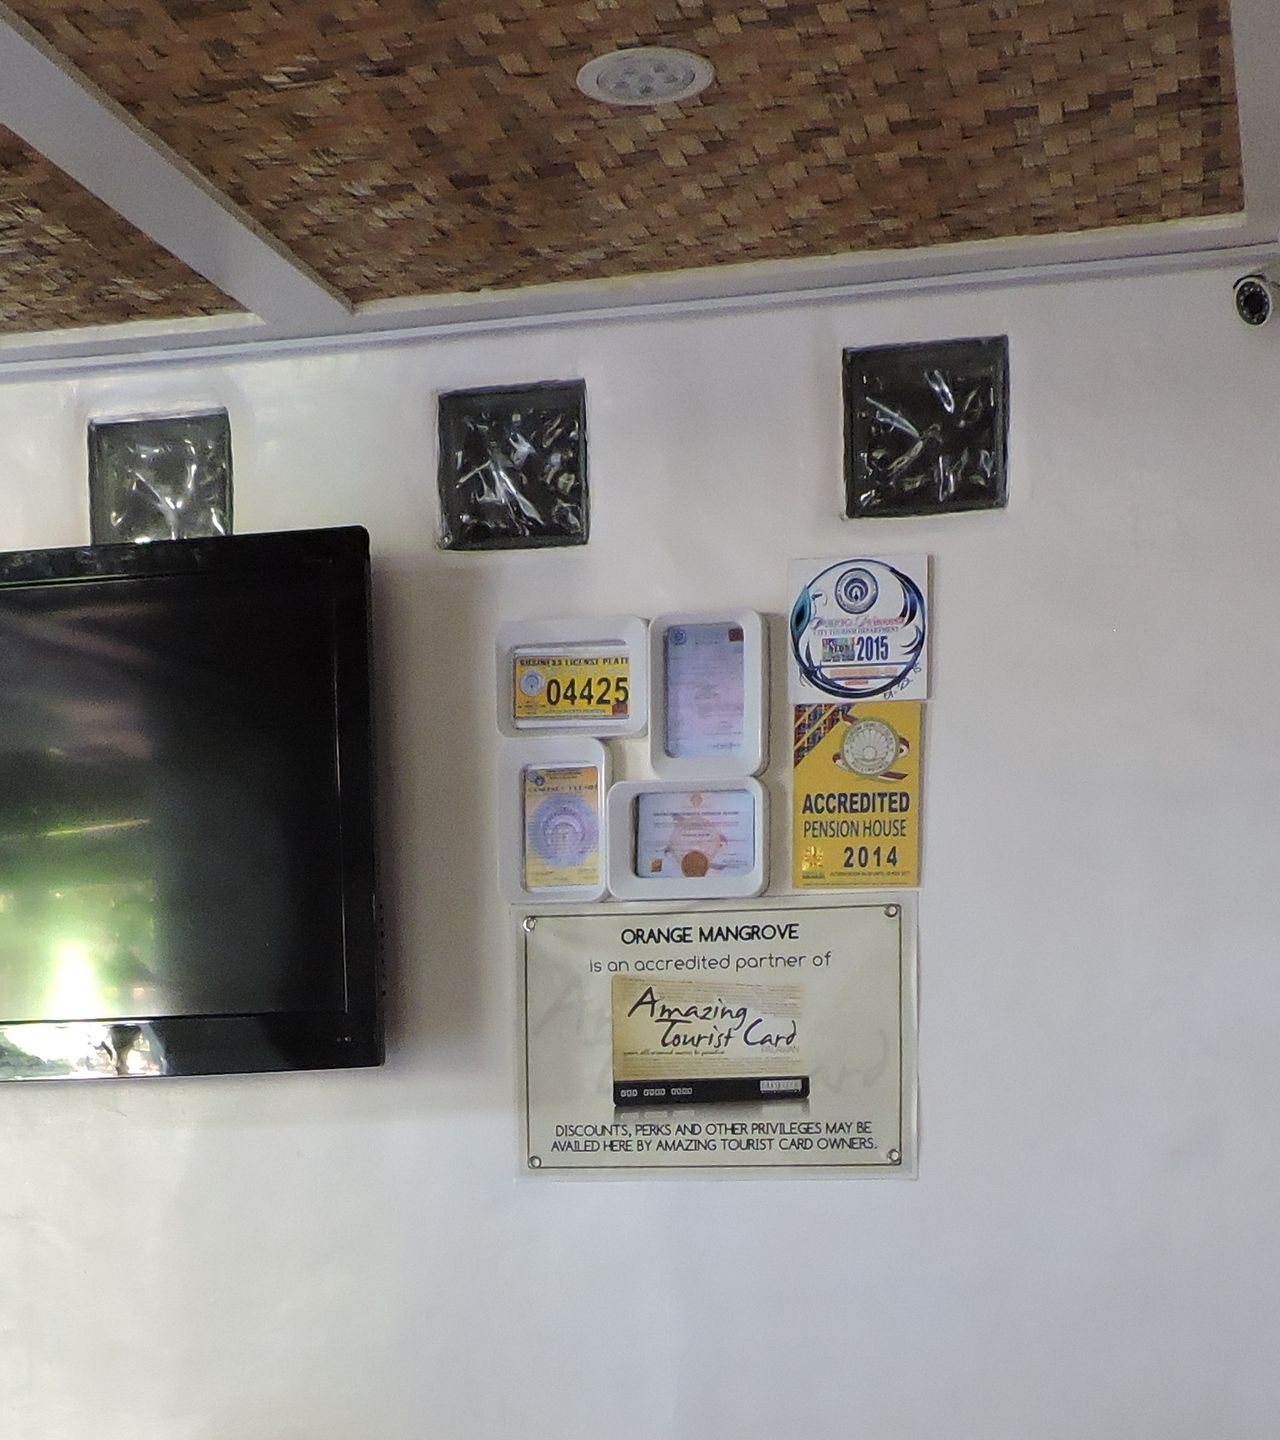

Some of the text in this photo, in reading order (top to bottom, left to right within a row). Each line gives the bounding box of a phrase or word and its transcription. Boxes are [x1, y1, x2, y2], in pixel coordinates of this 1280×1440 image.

[856, 635, 889, 661] 2015
[546, 677, 629, 706] 04425
[801, 791, 910, 815] ACCREDITED
[803, 818, 907, 838] PENSION HOUSE
[843, 845, 898, 868] 2014
[621, 923, 800, 944] ORANGE MANGROVE
[607, 958, 630, 972] an
[634, 954, 731, 972] accredited
[735, 952, 807, 972] partner
[812, 951, 832, 968] of
[627, 985, 748, 1031] Amazing
[654, 1017, 798, 1048] Tourist Card
[555, 1121, 872, 1138] DISCOUNTS, PERKS AND OTHER PRIVILEGES MAY BE
[551, 1137, 878, 1153] AVAILED HERE BY AMAZING TOURIST CARD OWNERS.
